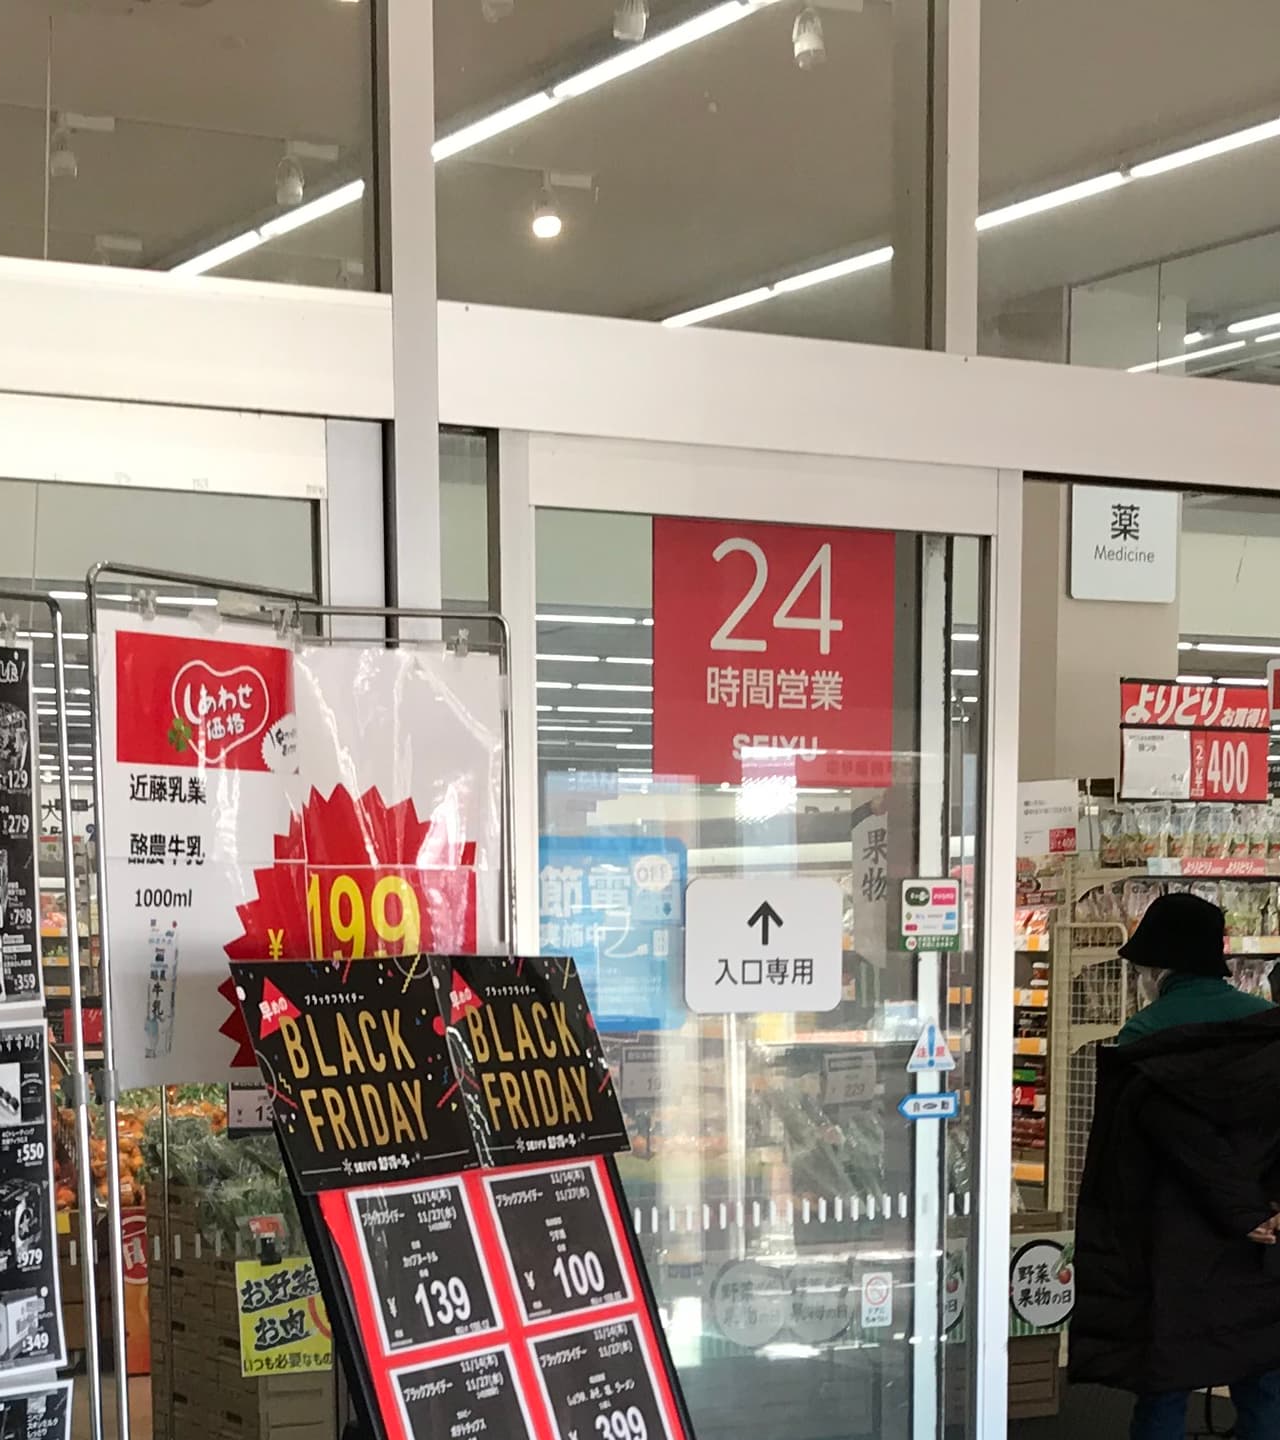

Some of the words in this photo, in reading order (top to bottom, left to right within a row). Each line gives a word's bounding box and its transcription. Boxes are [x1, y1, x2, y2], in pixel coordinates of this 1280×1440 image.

[1111, 503, 1141, 542] 薬
[1093, 544, 1156, 566] Medicine
[710, 536, 844, 655] 24
[184, 682, 253, 725] しあわせ
[706, 665, 844, 711] 時間営業
[1124, 684, 1226, 727] よりどり
[206, 711, 246, 742] 価格
[732, 733, 821, 763] SEIYU
[7, 769, 29, 789] 129
[1207, 740, 1249, 794] 400
[129, 773, 207, 805] 近藤乳業
[7, 814, 30, 834] 279
[129, 833, 206, 866] 酪農牛乳
[862, 827, 889, 904] 果物
[134, 888, 193, 909] 1000ml
[13, 907, 33, 925] 798
[267, 928, 285, 960] ¥
[307, 874, 423, 960] 199
[17, 973, 36, 990] 359
[714, 956, 815, 986] 入口専用
[304, 993, 365, 1006] ブラックフライデー
[484, 984, 537, 997] ブラックフライデー
[278, 1007, 417, 1080] BLACK
[465, 1001, 581, 1064] BLACK
[480, 1065, 594, 1132] FRIDAY
[299, 1079, 429, 1153] FRIDAY
[22, 1142, 44, 1162] 550
[352, 1161, 378, 1175] SEIYU
[21, 1248, 43, 1266] 979
[240, 1264, 321, 1310] お野菜
[523, 1270, 536, 1291] ¥
[553, 1250, 605, 1299] 100
[1017, 1262, 1051, 1285] 野菜
[387, 1296, 398, 1319] ¥
[414, 1276, 471, 1328] 139
[1017, 1286, 1072, 1308] 果物の日
[26, 1332, 49, 1351] 349
[253, 1308, 310, 1350] お肉
